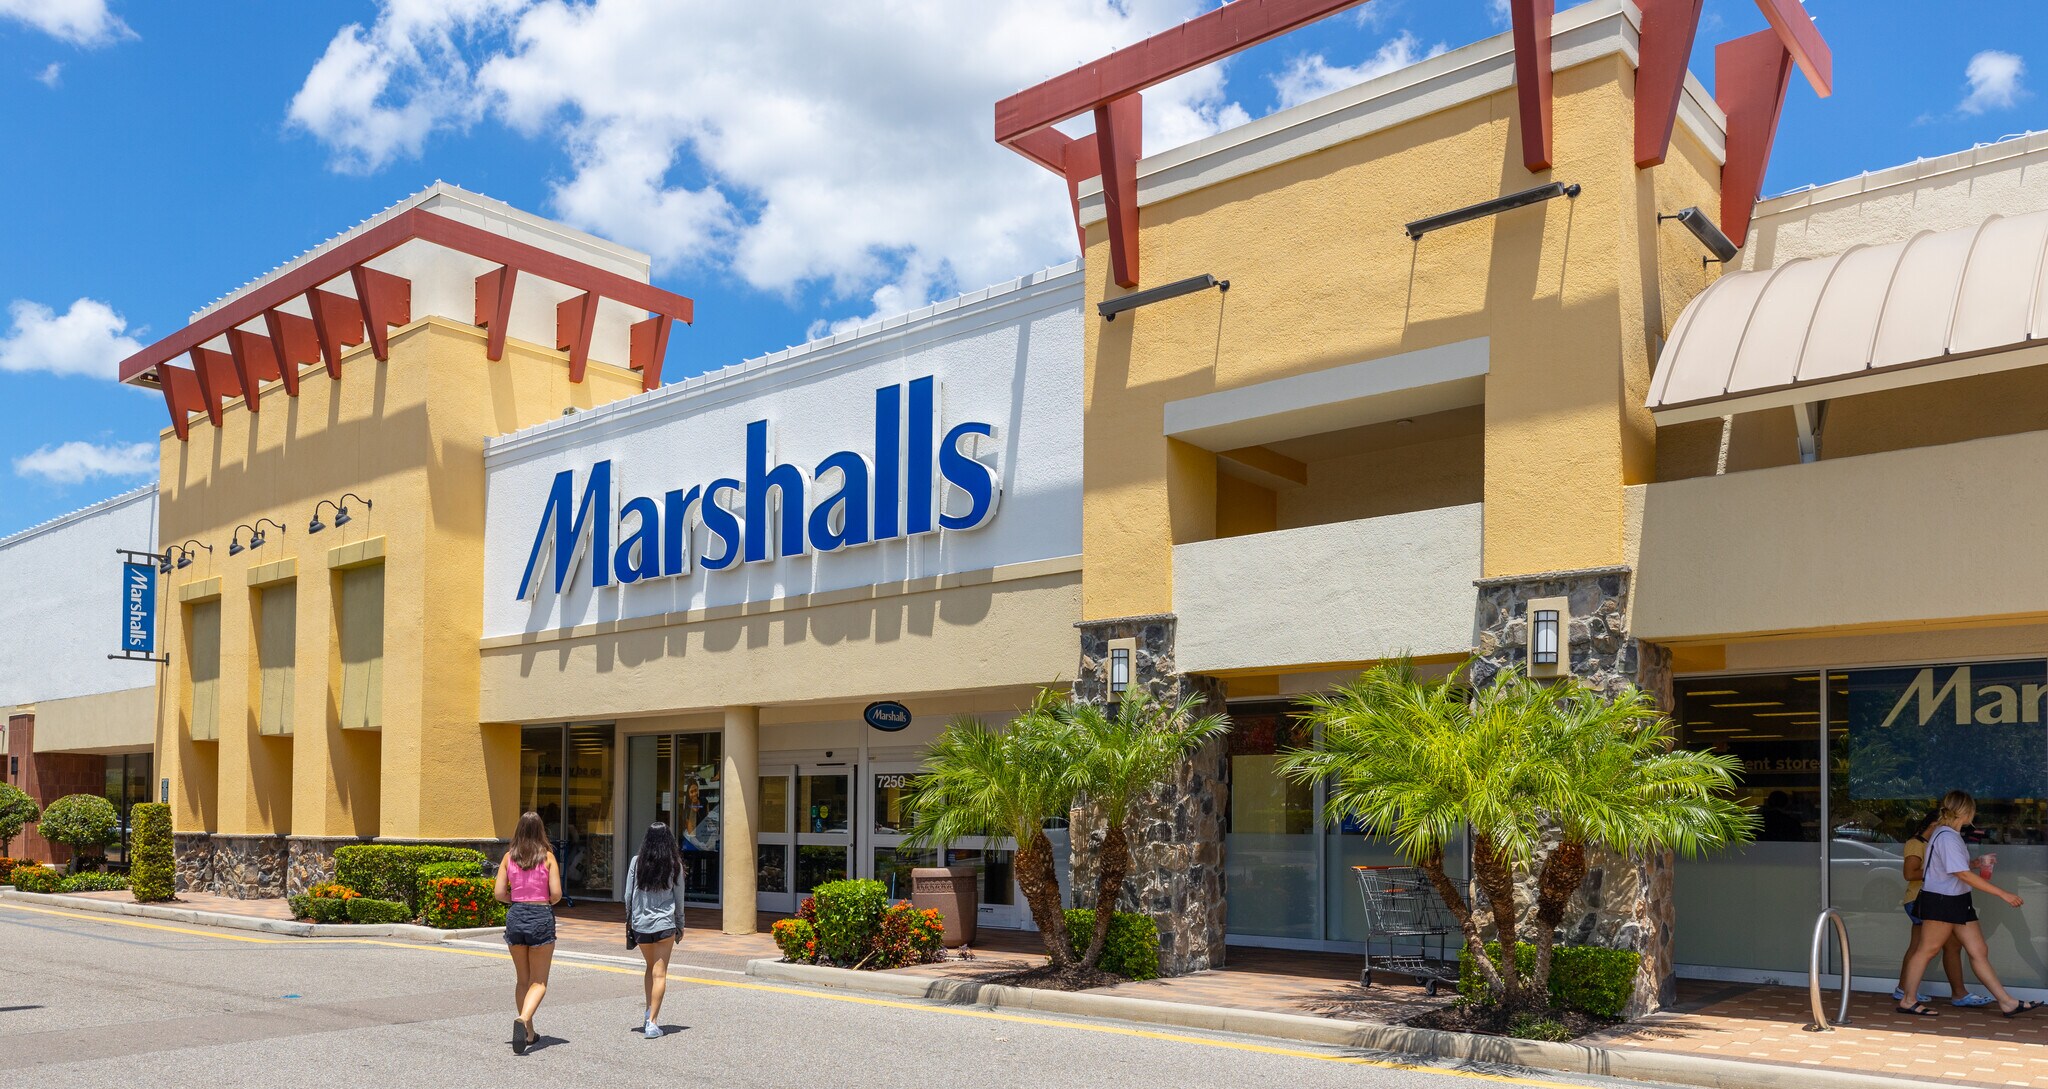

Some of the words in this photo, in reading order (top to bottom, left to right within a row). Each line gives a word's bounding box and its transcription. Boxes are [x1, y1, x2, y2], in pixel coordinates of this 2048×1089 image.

[515, 375, 996, 600] Marshalls
[129, 567, 148, 647] Marshalls
[872, 709, 907, 723] Marshalls
[1745, 757, 1770, 770] ent
[877, 775, 906, 788] 7250
